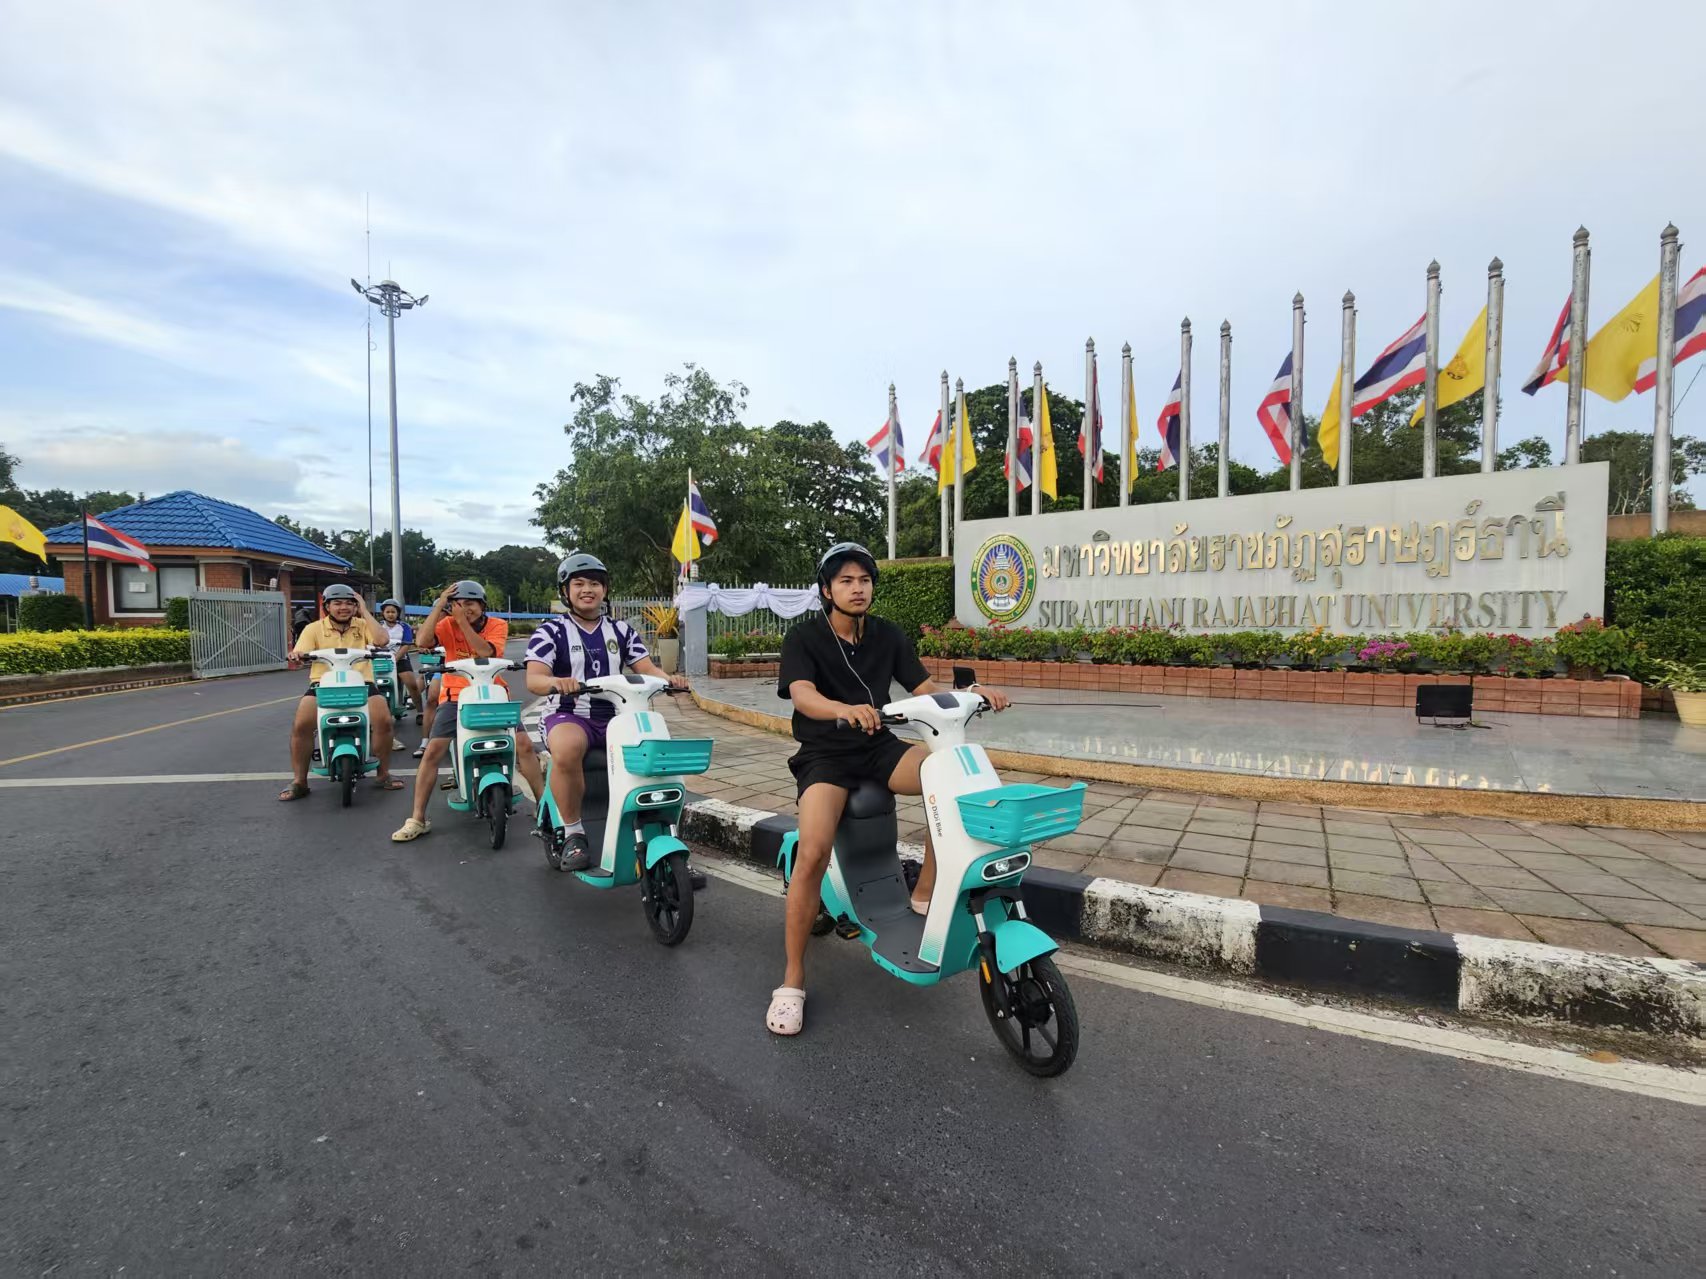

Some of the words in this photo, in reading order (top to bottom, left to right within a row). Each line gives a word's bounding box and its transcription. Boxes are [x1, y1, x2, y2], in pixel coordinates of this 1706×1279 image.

[1039, 597, 1185, 627] SURATTHANI
[1192, 594, 1336, 627] RAJABHAT
[1343, 591, 1567, 628] UNIVERSITY
[592, 660, 600, 677] 9
